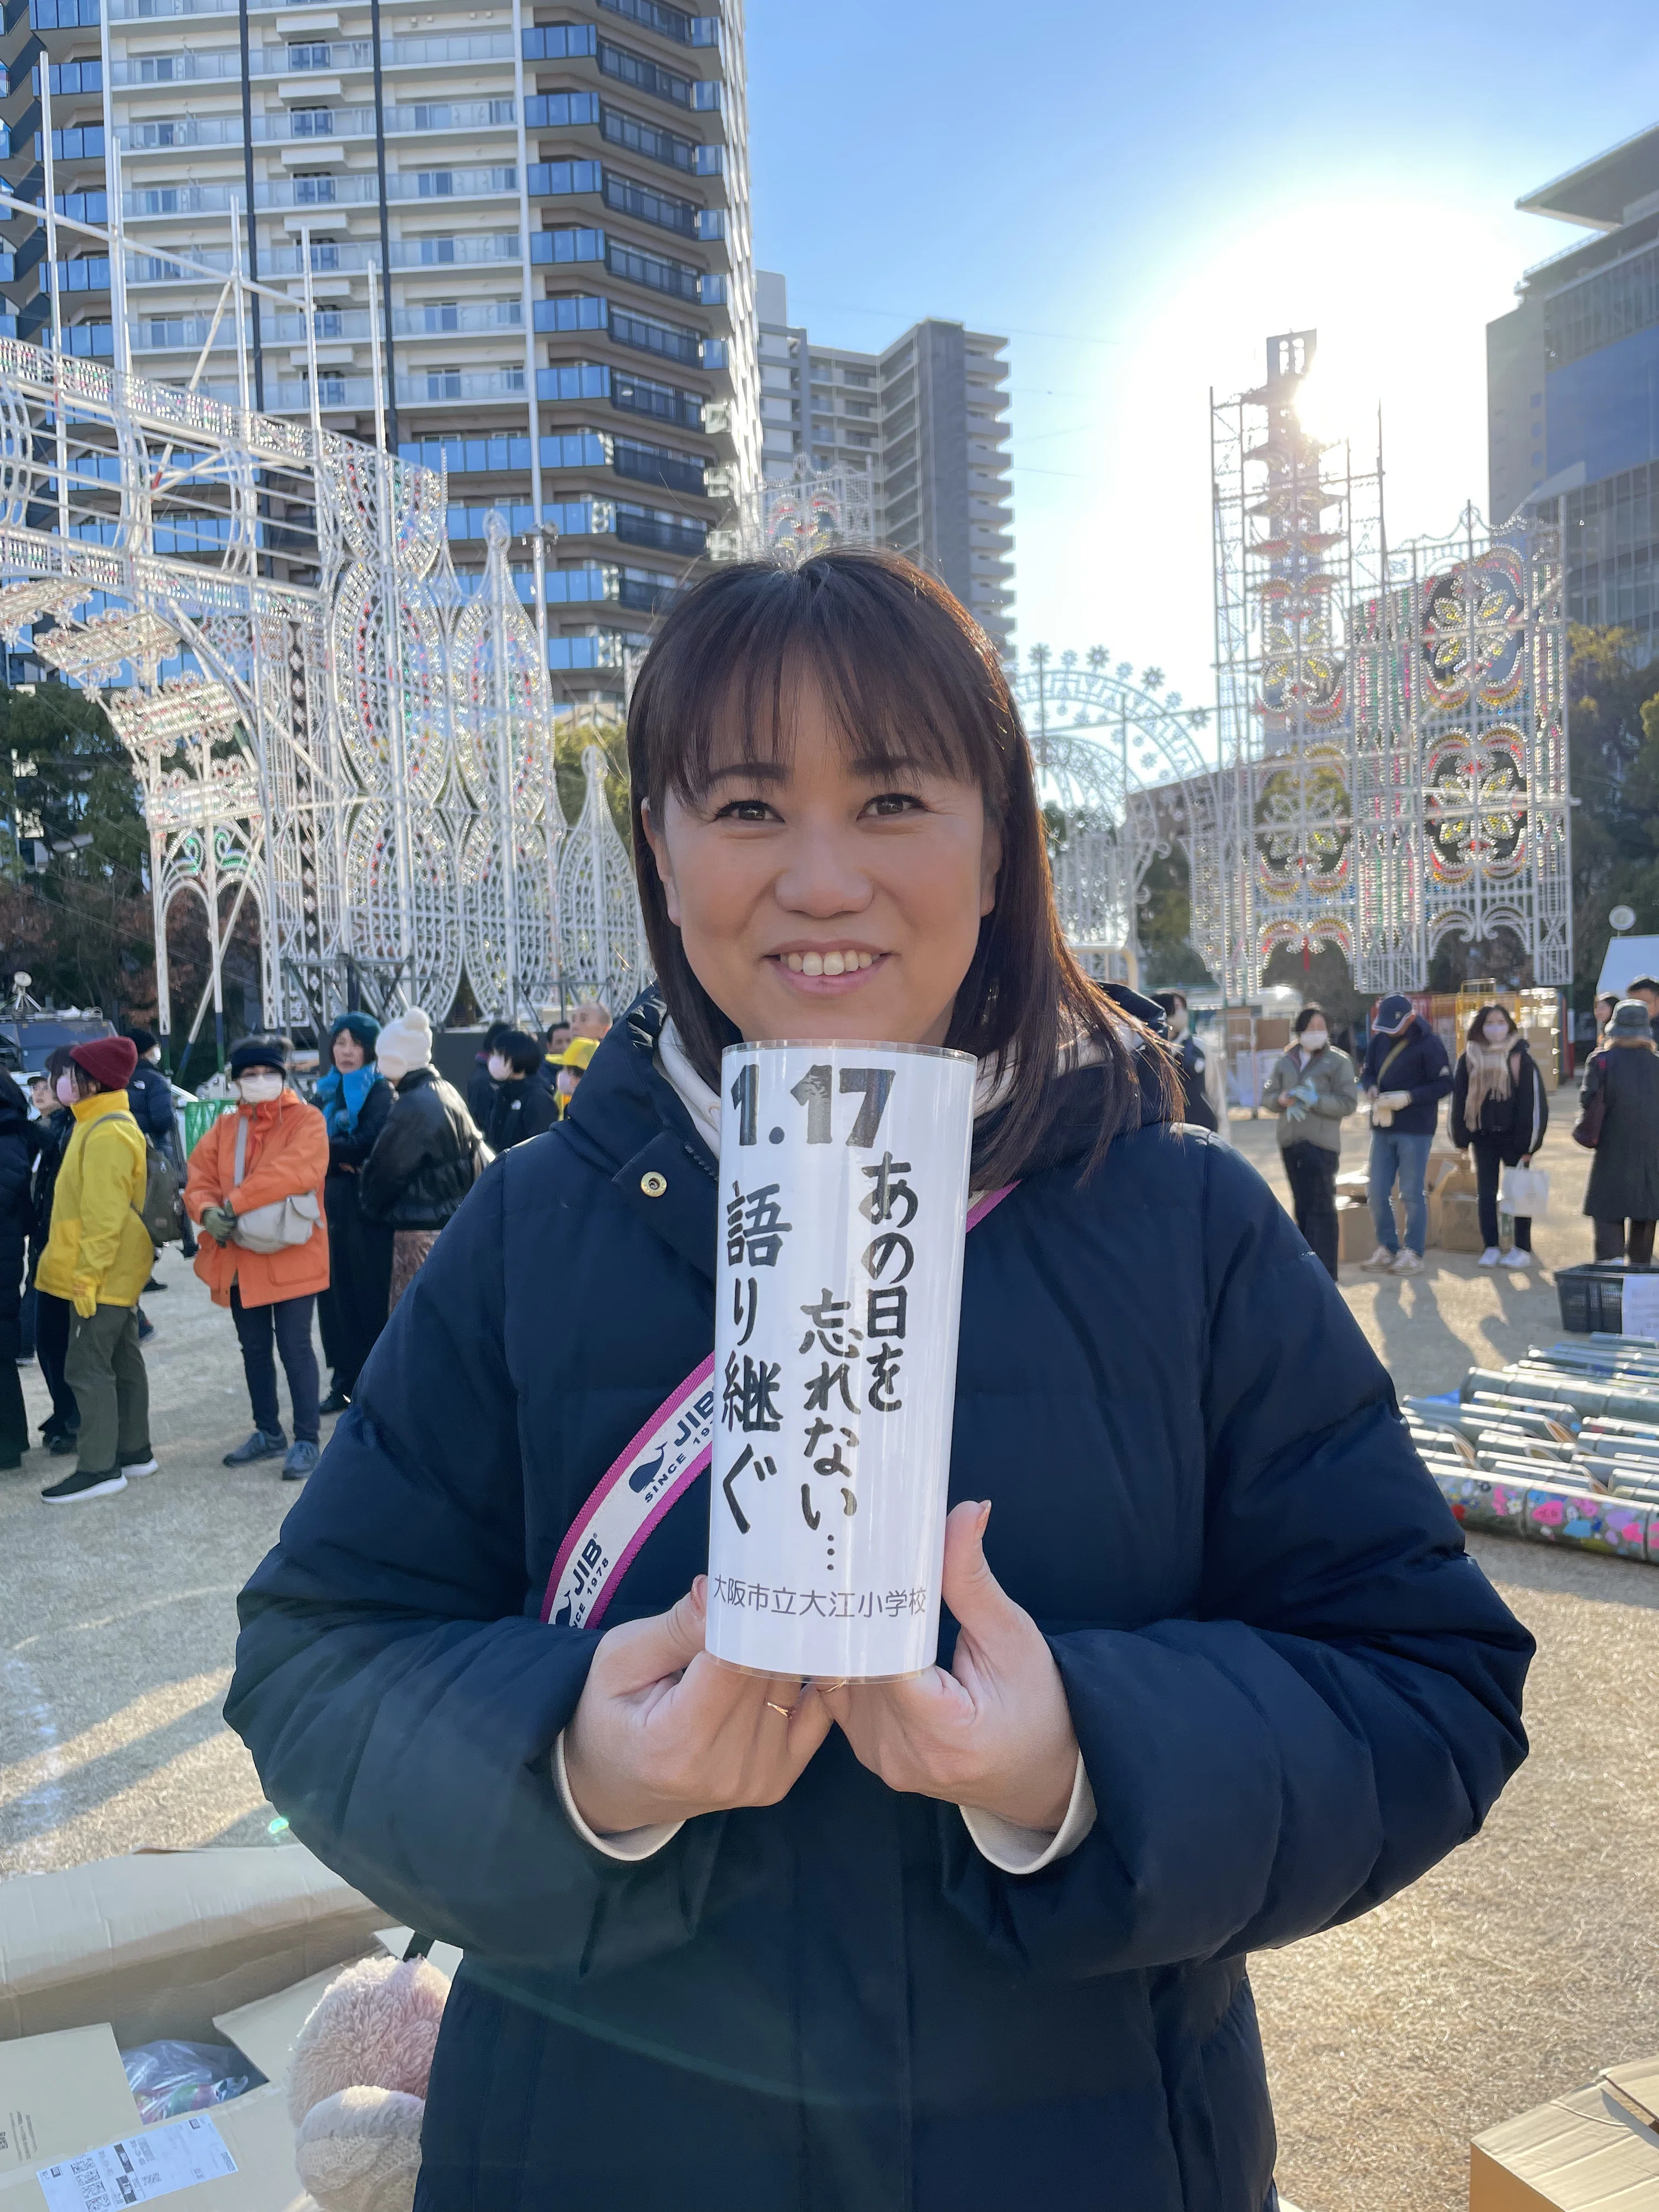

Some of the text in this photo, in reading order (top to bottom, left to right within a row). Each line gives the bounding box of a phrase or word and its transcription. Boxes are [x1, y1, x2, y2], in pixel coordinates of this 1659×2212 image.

[730, 1064, 896, 1148] 1.17
[857, 1150, 919, 1412] あの日を
[721, 1180, 793, 1534] 語り継ぐ
[645, 1453, 686, 1503] SINCE
[587, 1558, 609, 1595] 1978
[713, 1573, 928, 1618] 大阪市立大江小学校
